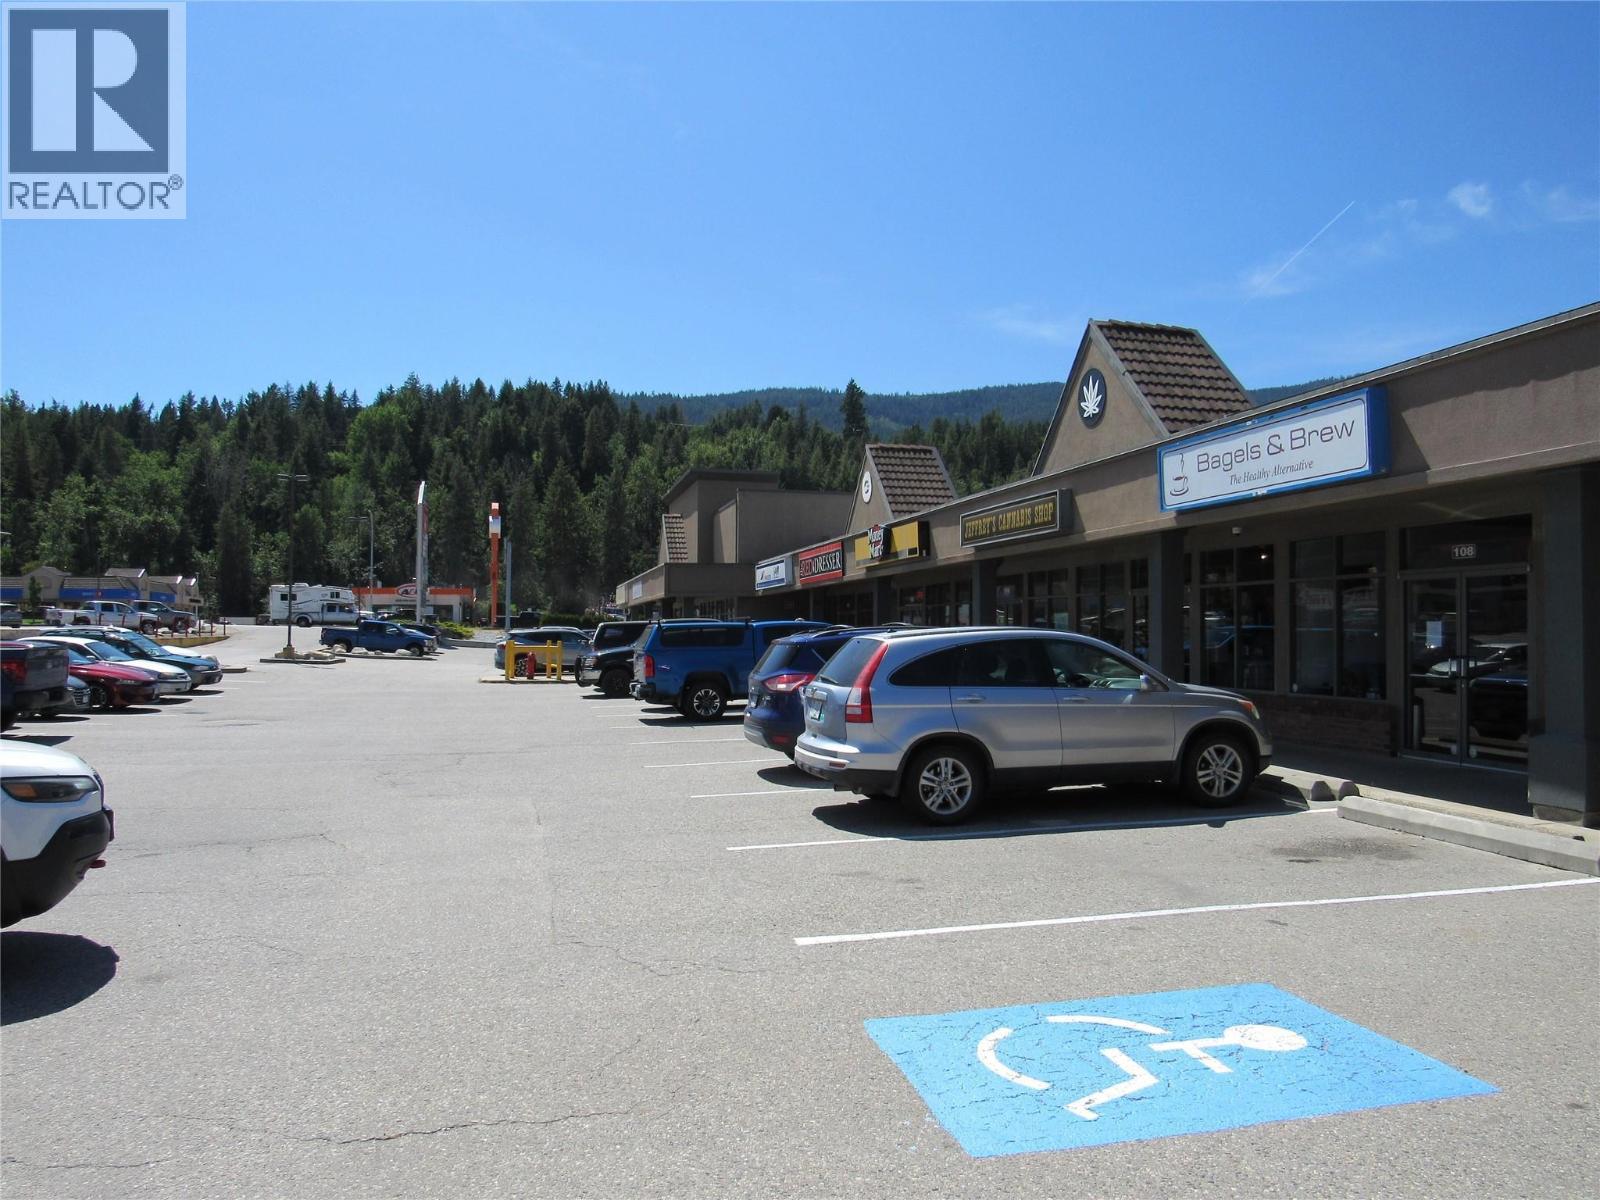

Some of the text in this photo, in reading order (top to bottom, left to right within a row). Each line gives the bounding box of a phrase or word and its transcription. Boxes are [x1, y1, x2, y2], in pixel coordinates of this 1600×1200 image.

[1197, 419, 1356, 473] Bagels & Brew
[1230, 459, 1314, 486] The Healthy Alternative
[998, 506, 1032, 531] CANNABIS
[1034, 502, 1054, 524] SHOP
[1454, 546, 1474, 557] 108
